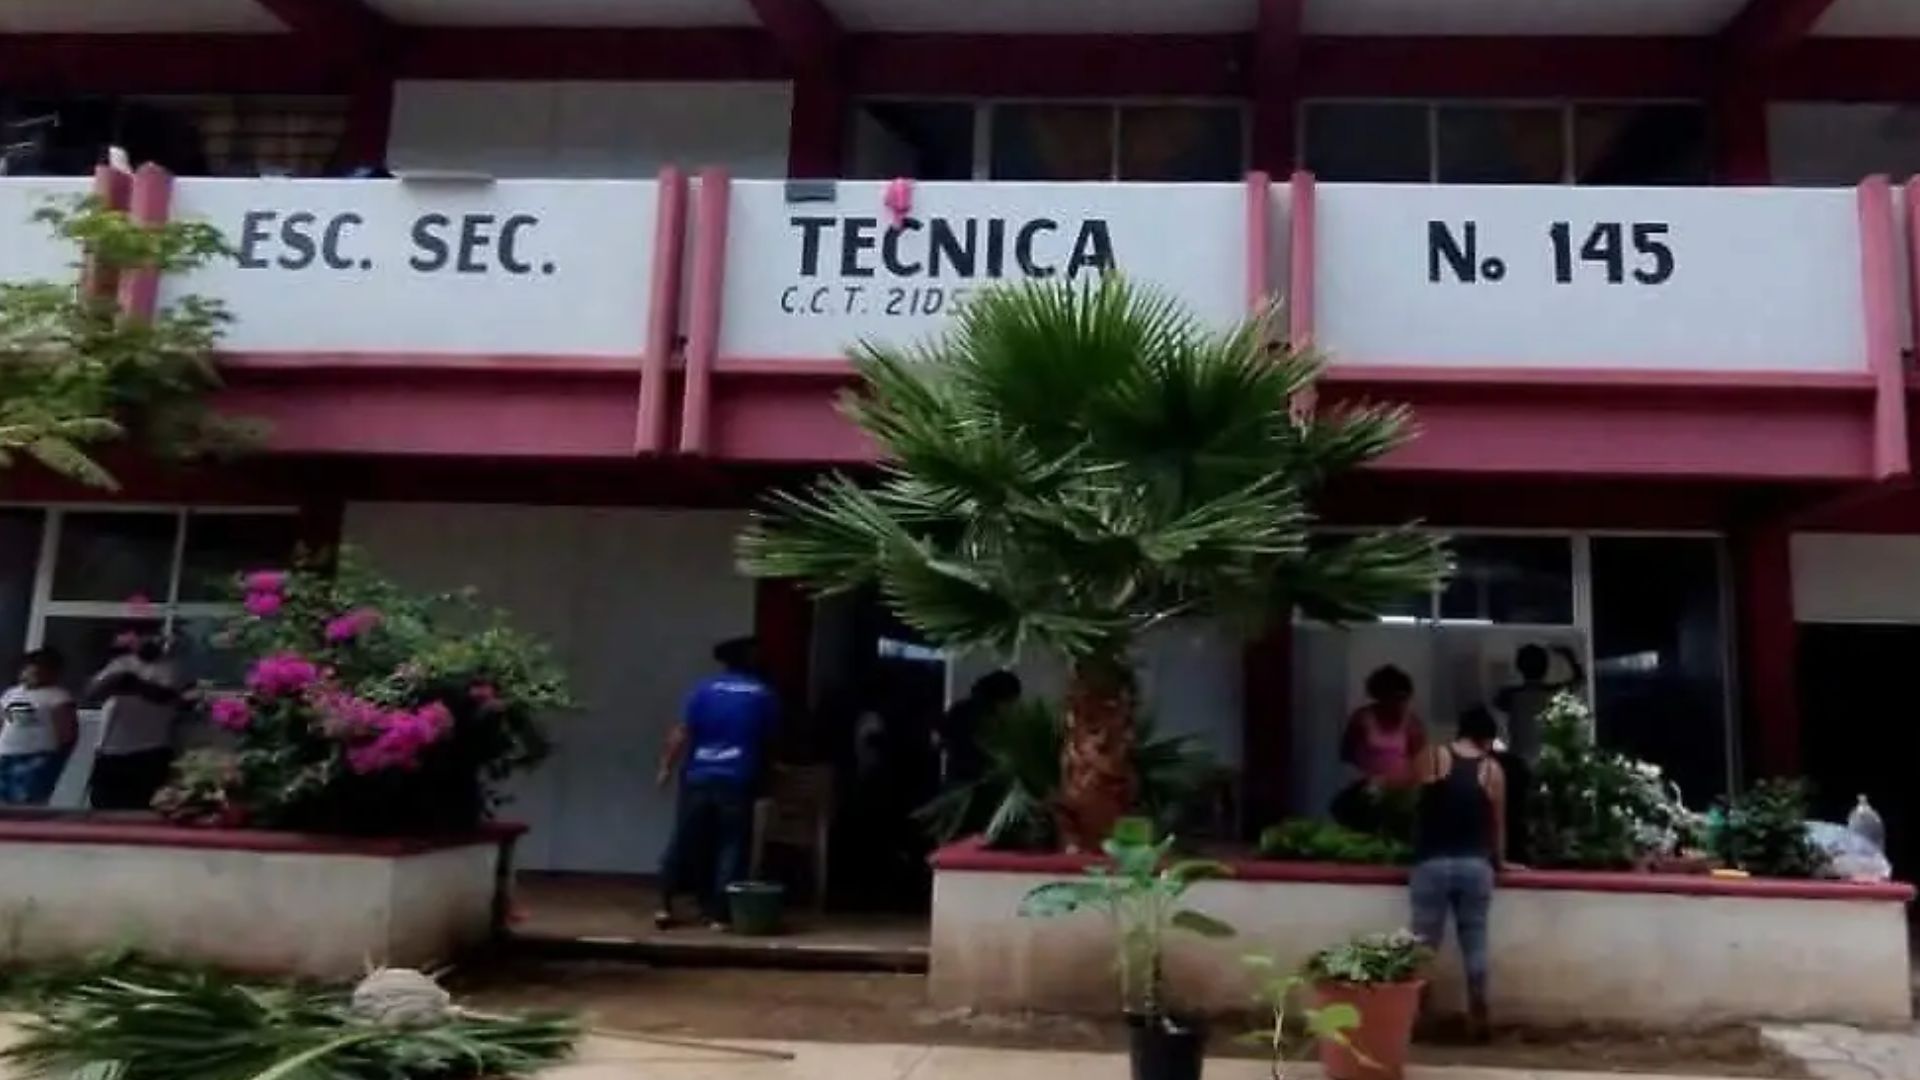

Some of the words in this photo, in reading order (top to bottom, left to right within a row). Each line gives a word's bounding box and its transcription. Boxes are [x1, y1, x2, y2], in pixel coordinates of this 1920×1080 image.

[239, 211, 372, 270] ESC.
[409, 213, 555, 275] SEC.
[791, 216, 1116, 279] TECNICA
[1550, 221, 1675, 284] 145
